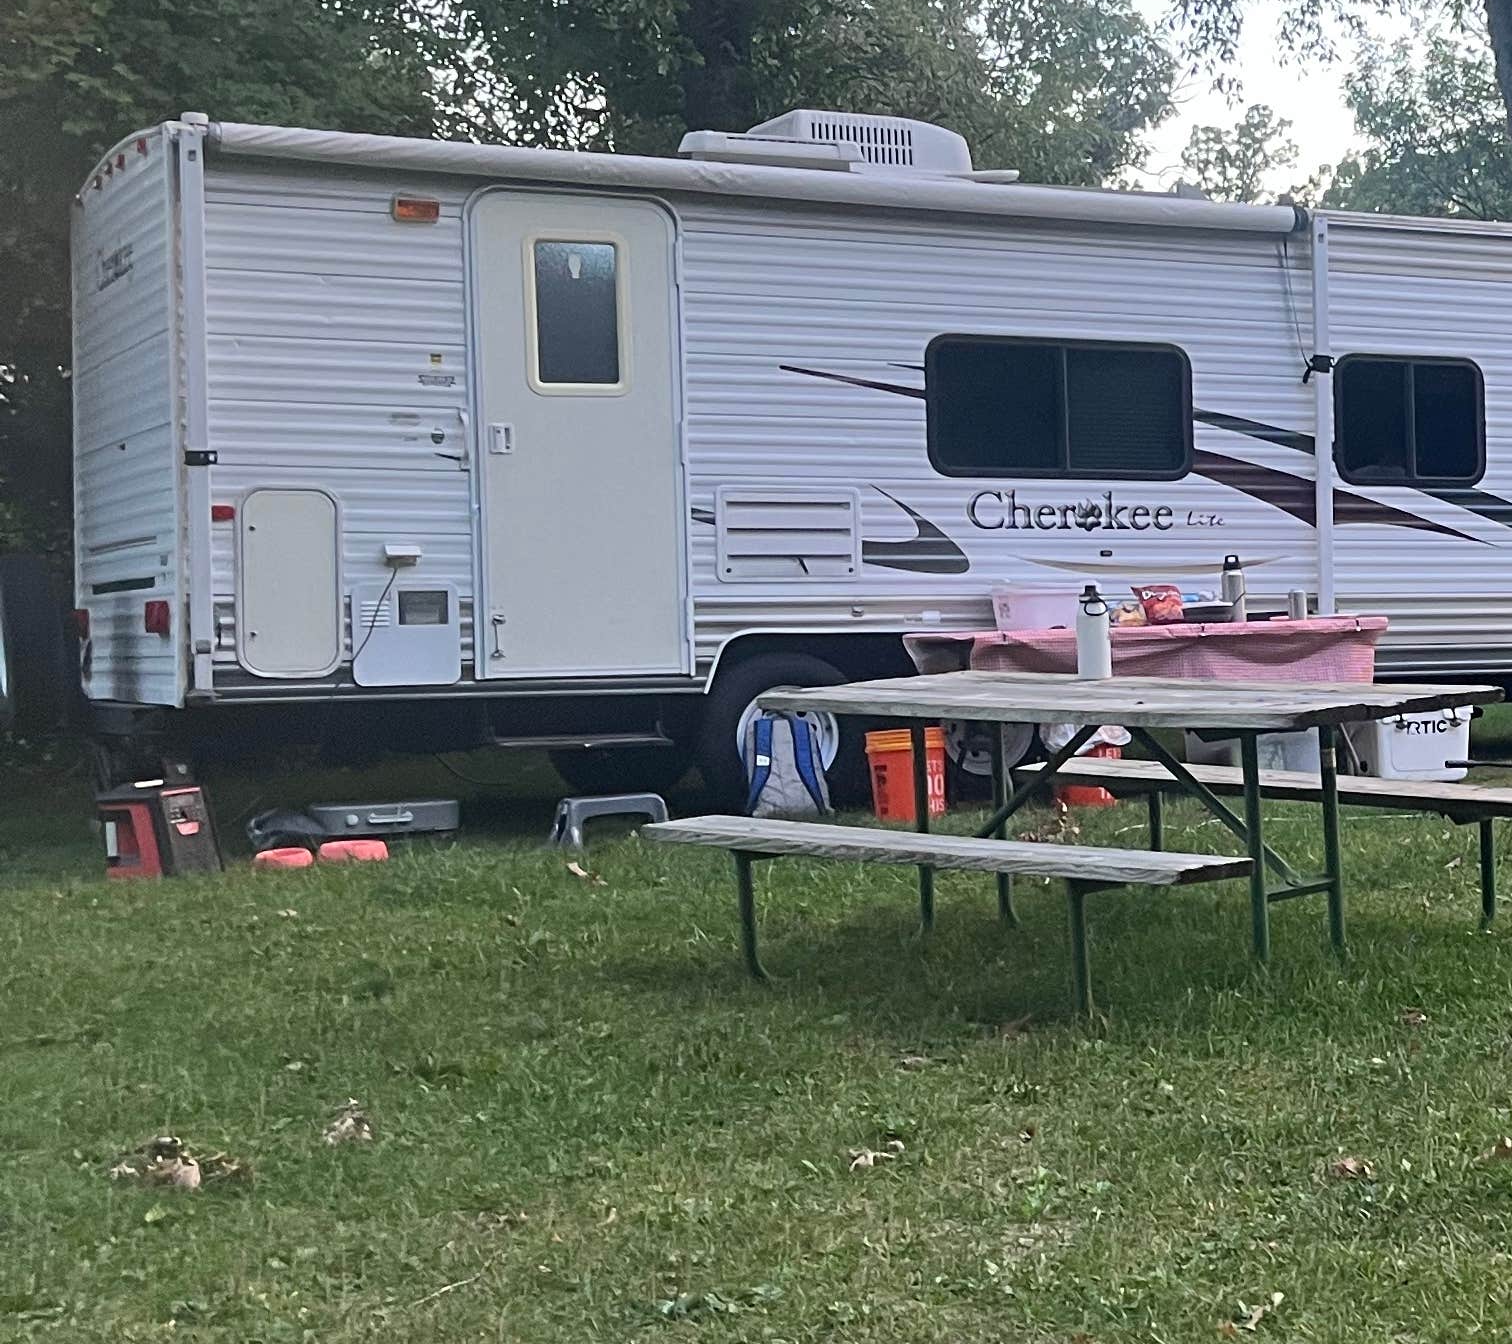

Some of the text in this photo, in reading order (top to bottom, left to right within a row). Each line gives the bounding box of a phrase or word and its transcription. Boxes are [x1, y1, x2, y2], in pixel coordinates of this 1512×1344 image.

[967, 489, 1225, 531] Cherokee Lite
[1406, 720, 1448, 735] RTIC
